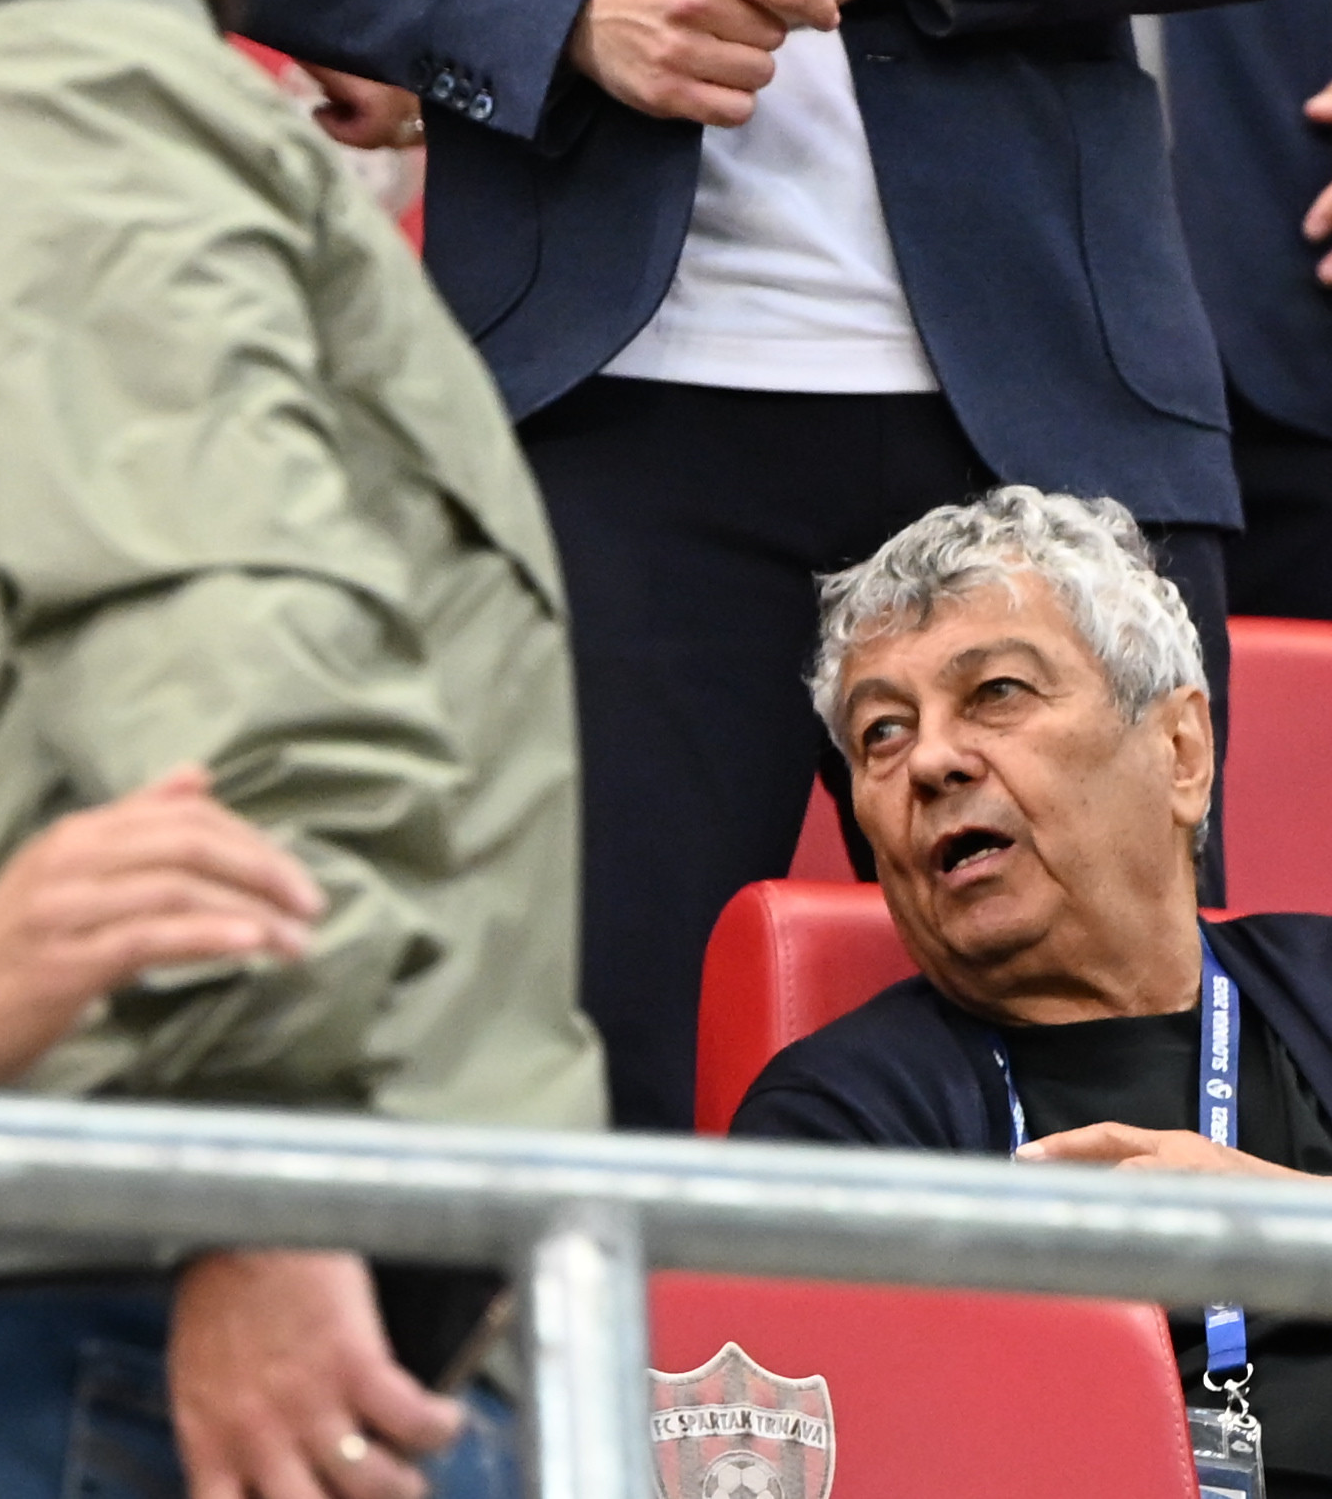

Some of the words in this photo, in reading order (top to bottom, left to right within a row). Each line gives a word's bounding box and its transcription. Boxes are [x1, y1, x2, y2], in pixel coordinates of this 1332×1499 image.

[653, 1417, 676, 1436] FC
[678, 1410, 752, 1432] SPARTAK
[757, 1414, 823, 1443] TRNAVA
